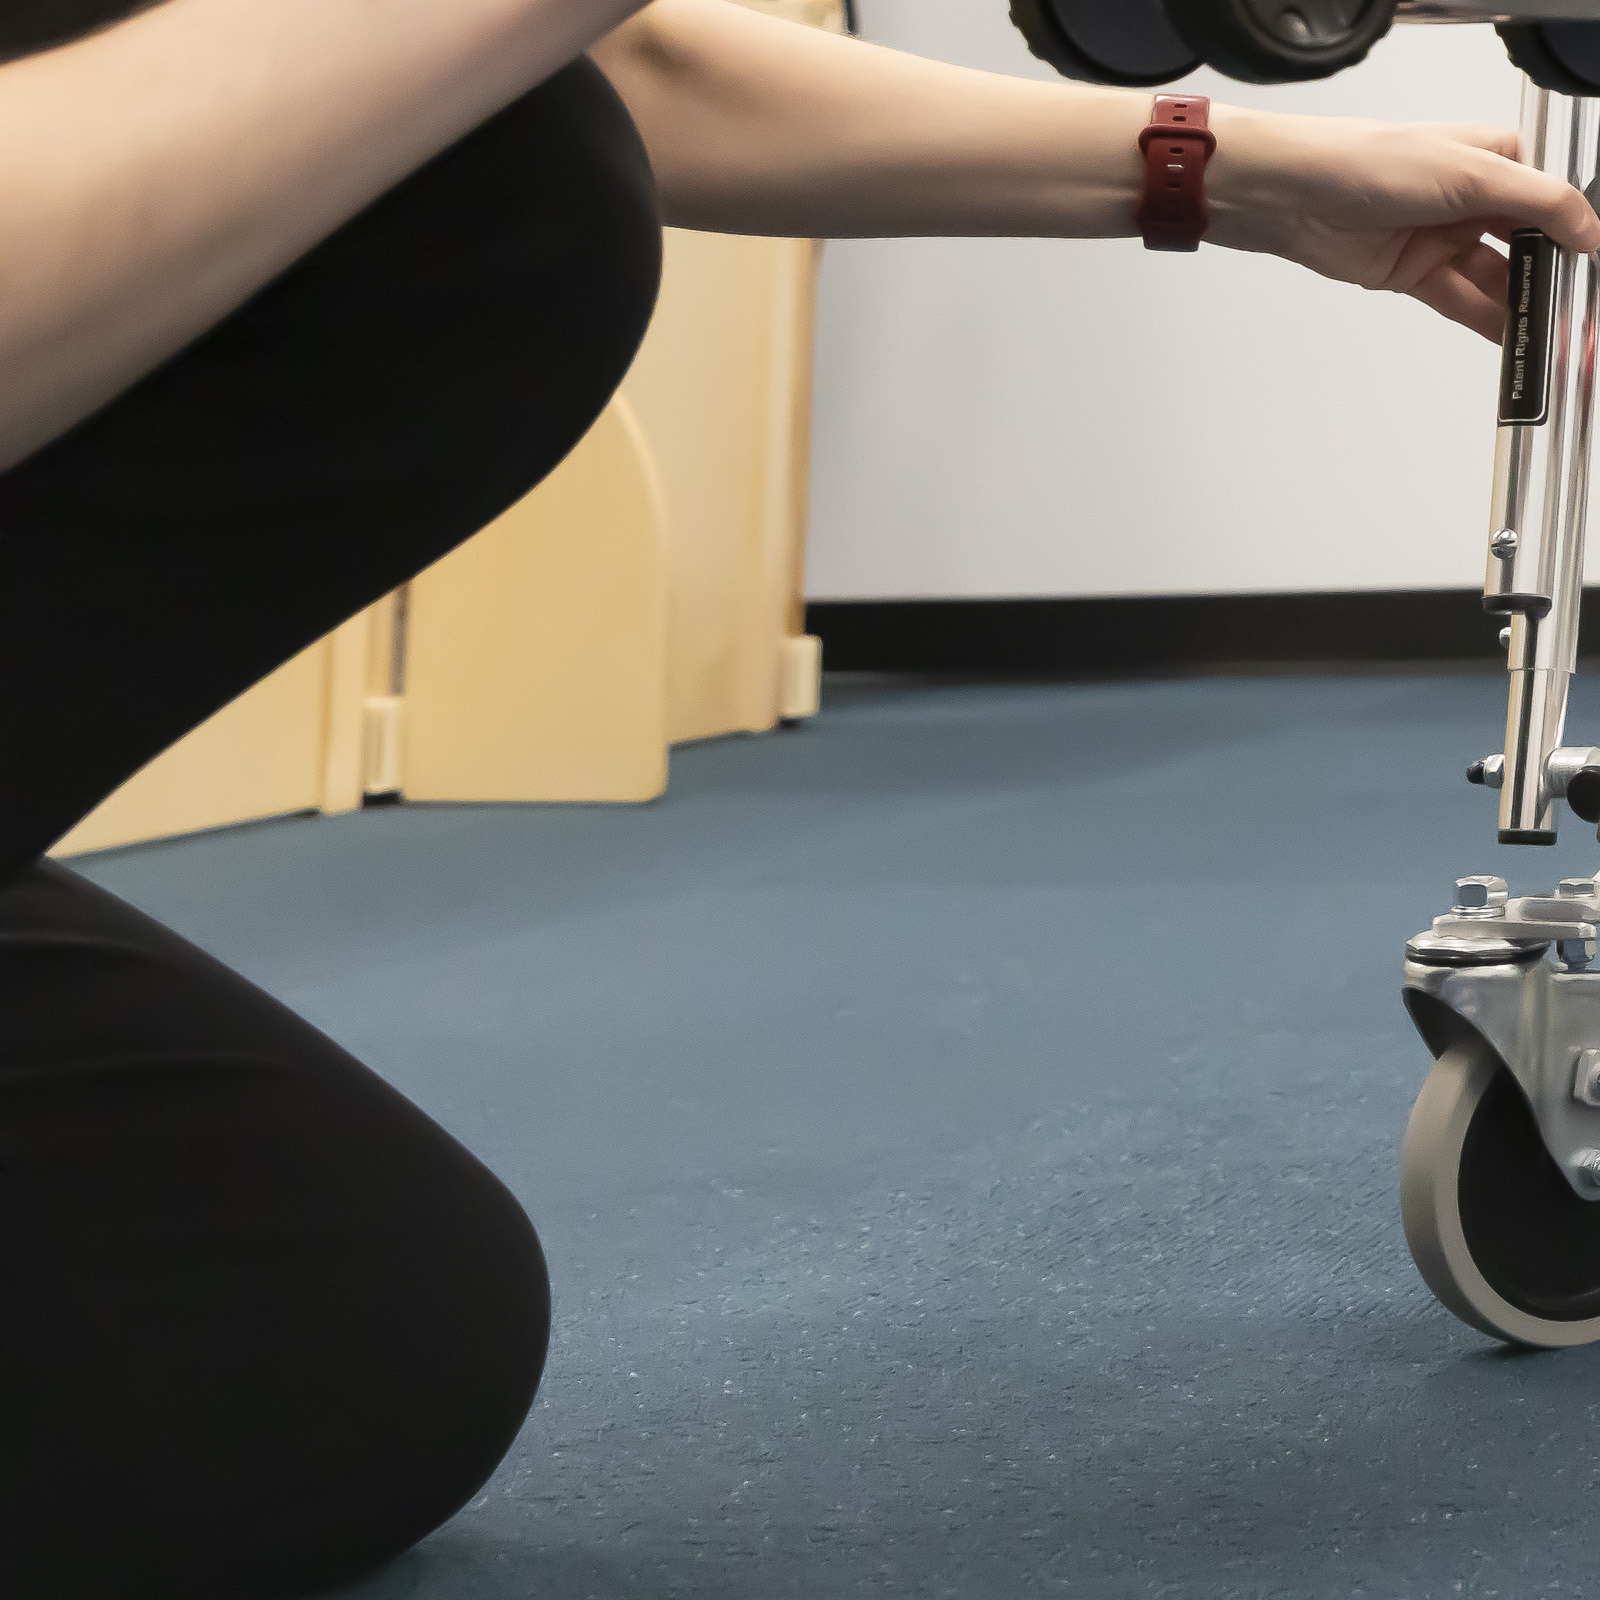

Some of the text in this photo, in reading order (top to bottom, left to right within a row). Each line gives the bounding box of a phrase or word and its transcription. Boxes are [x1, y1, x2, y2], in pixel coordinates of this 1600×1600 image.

[1512, 255, 1533, 400] Patent Rights Reserved
